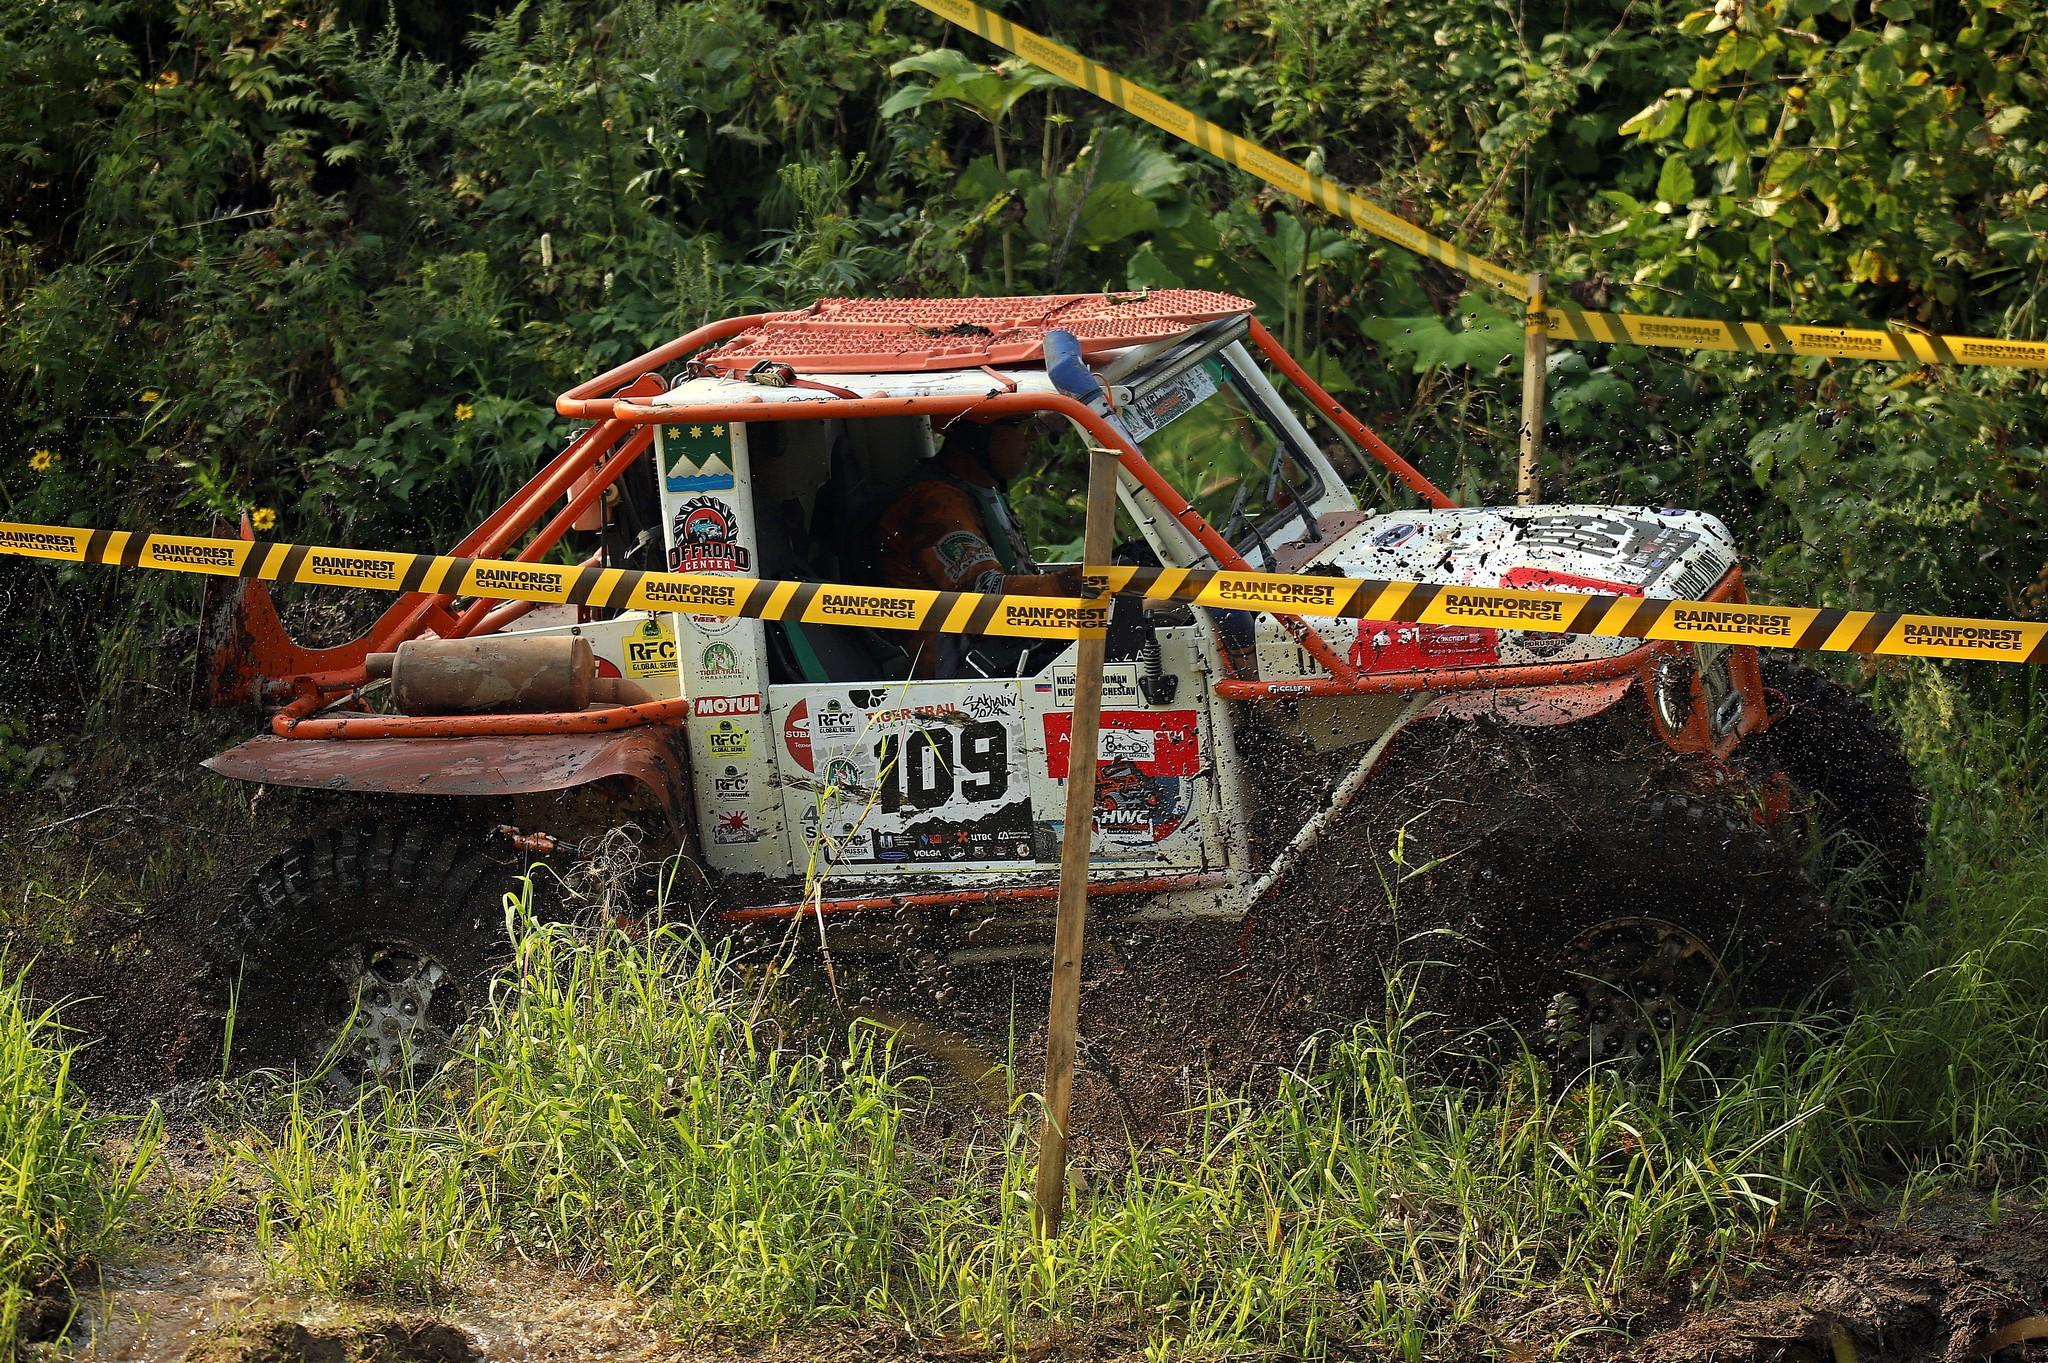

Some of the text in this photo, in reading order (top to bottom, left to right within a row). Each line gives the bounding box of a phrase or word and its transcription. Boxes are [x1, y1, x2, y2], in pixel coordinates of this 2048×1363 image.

[0, 541, 78, 553] CHALLENGE
[152, 543, 234, 559] RAINFOREST
[153, 554, 235, 567] CHALLENGE
[669, 541, 750, 571] OFFROAD
[312, 556, 395, 572] RAINFOREST
[685, 560, 731, 570] CENTER
[312, 566, 395, 580] CHALLENGE
[475, 568, 562, 584] RAINFOREST
[475, 580, 562, 593] CHALLENGE
[645, 581, 735, 597] RAINFOREST
[1219, 580, 1334, 597] RAINFOREST
[645, 592, 735, 606] CHALLENGE
[822, 594, 915, 610] RAINFOREST
[1220, 592, 1334, 605] CHALLENGE
[1446, 594, 1562, 612] RAINFOREST
[822, 606, 916, 619] CHALLENGE
[1006, 605, 1106, 620] RAINFOREST
[1445, 607, 1562, 621] CHALLENGE
[1673, 610, 1791, 627] RAINFOREST
[1006, 617, 1107, 628] CHALLENGE
[1673, 622, 1791, 635] CHALLENGE
[1904, 624, 2022, 641] RAINFOREST
[1903, 636, 2022, 650] CHALLENGE
[632, 661, 678, 671] GLOBAL SERIE
[697, 697, 758, 714] MOTUL
[874, 720, 1009, 814] 109
[1101, 810, 1149, 824] HWC
[913, 849, 942, 857] VOLGA
